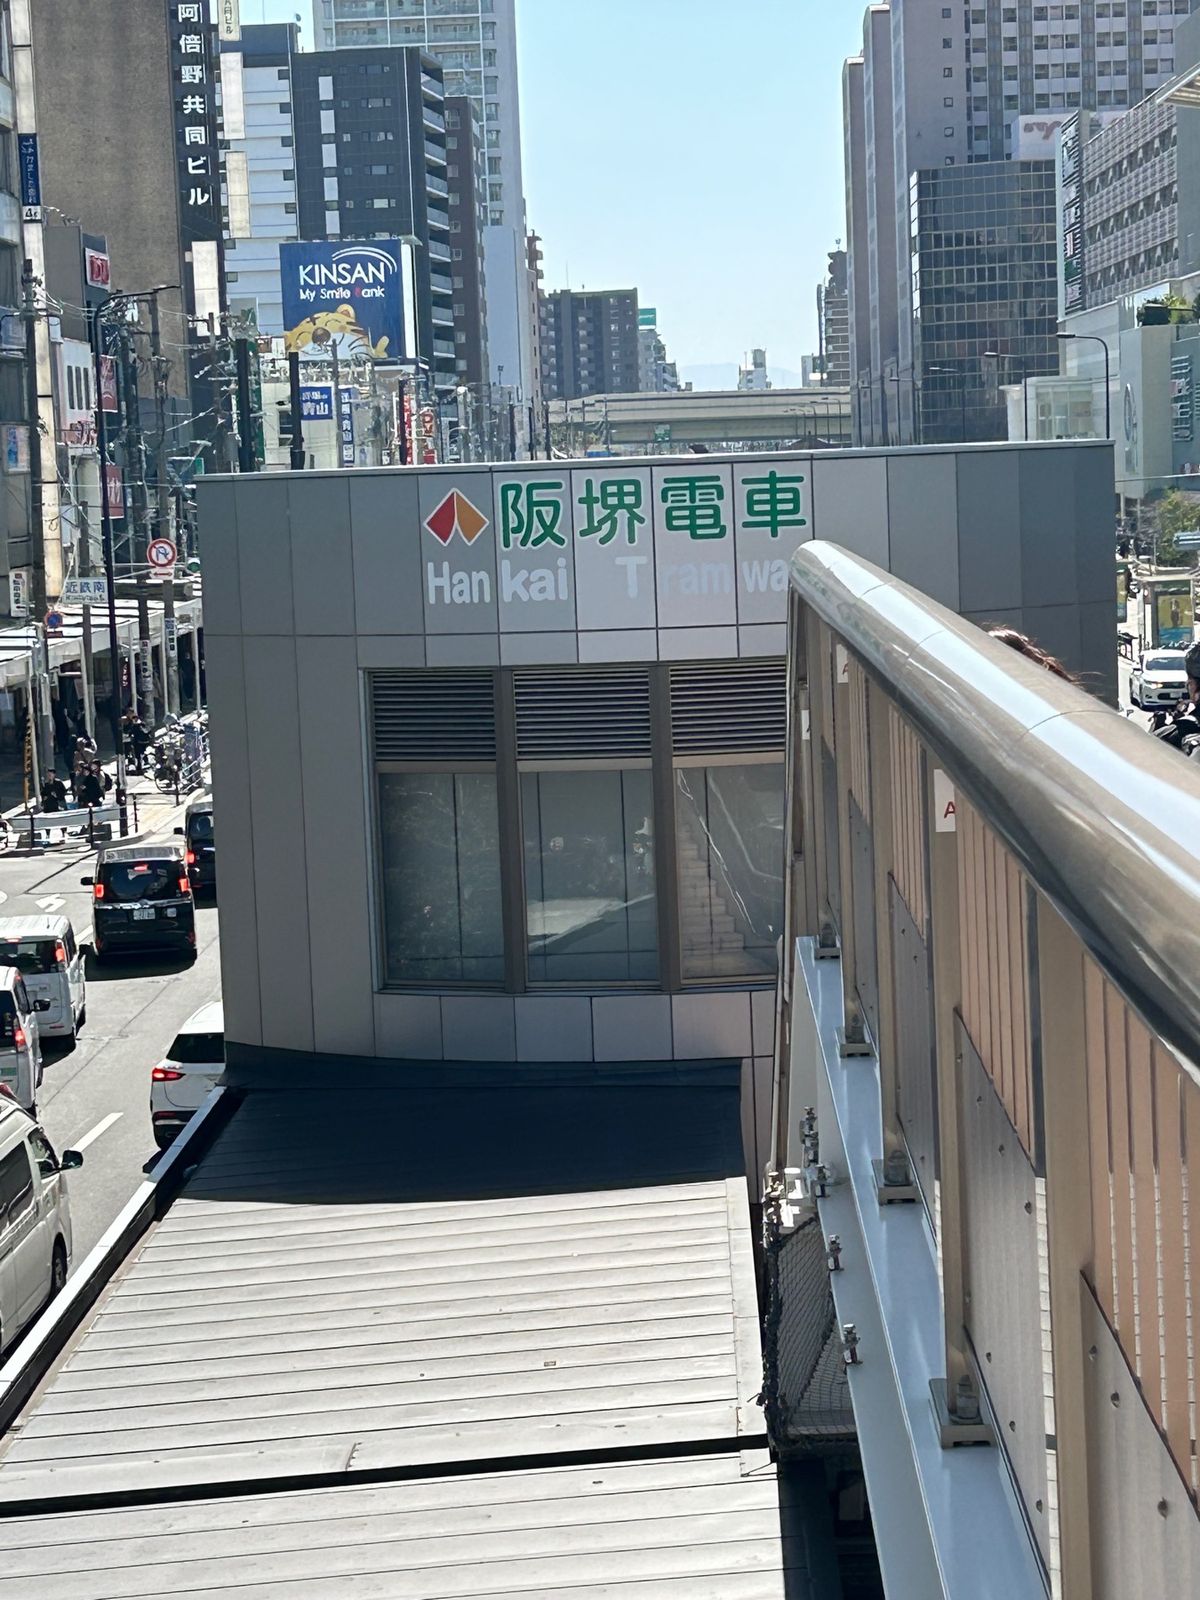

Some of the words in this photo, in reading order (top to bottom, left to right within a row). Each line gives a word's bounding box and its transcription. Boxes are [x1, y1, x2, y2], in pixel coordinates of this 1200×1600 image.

[177, 3, 210, 206] 阿倍野共同ビル
[299, 262, 386, 286] KINSAN
[299, 288, 316, 302] My
[320, 286, 351, 300] Smile
[500, 470, 808, 549] 阪堺電車
[427, 557, 568, 605] Hankai
